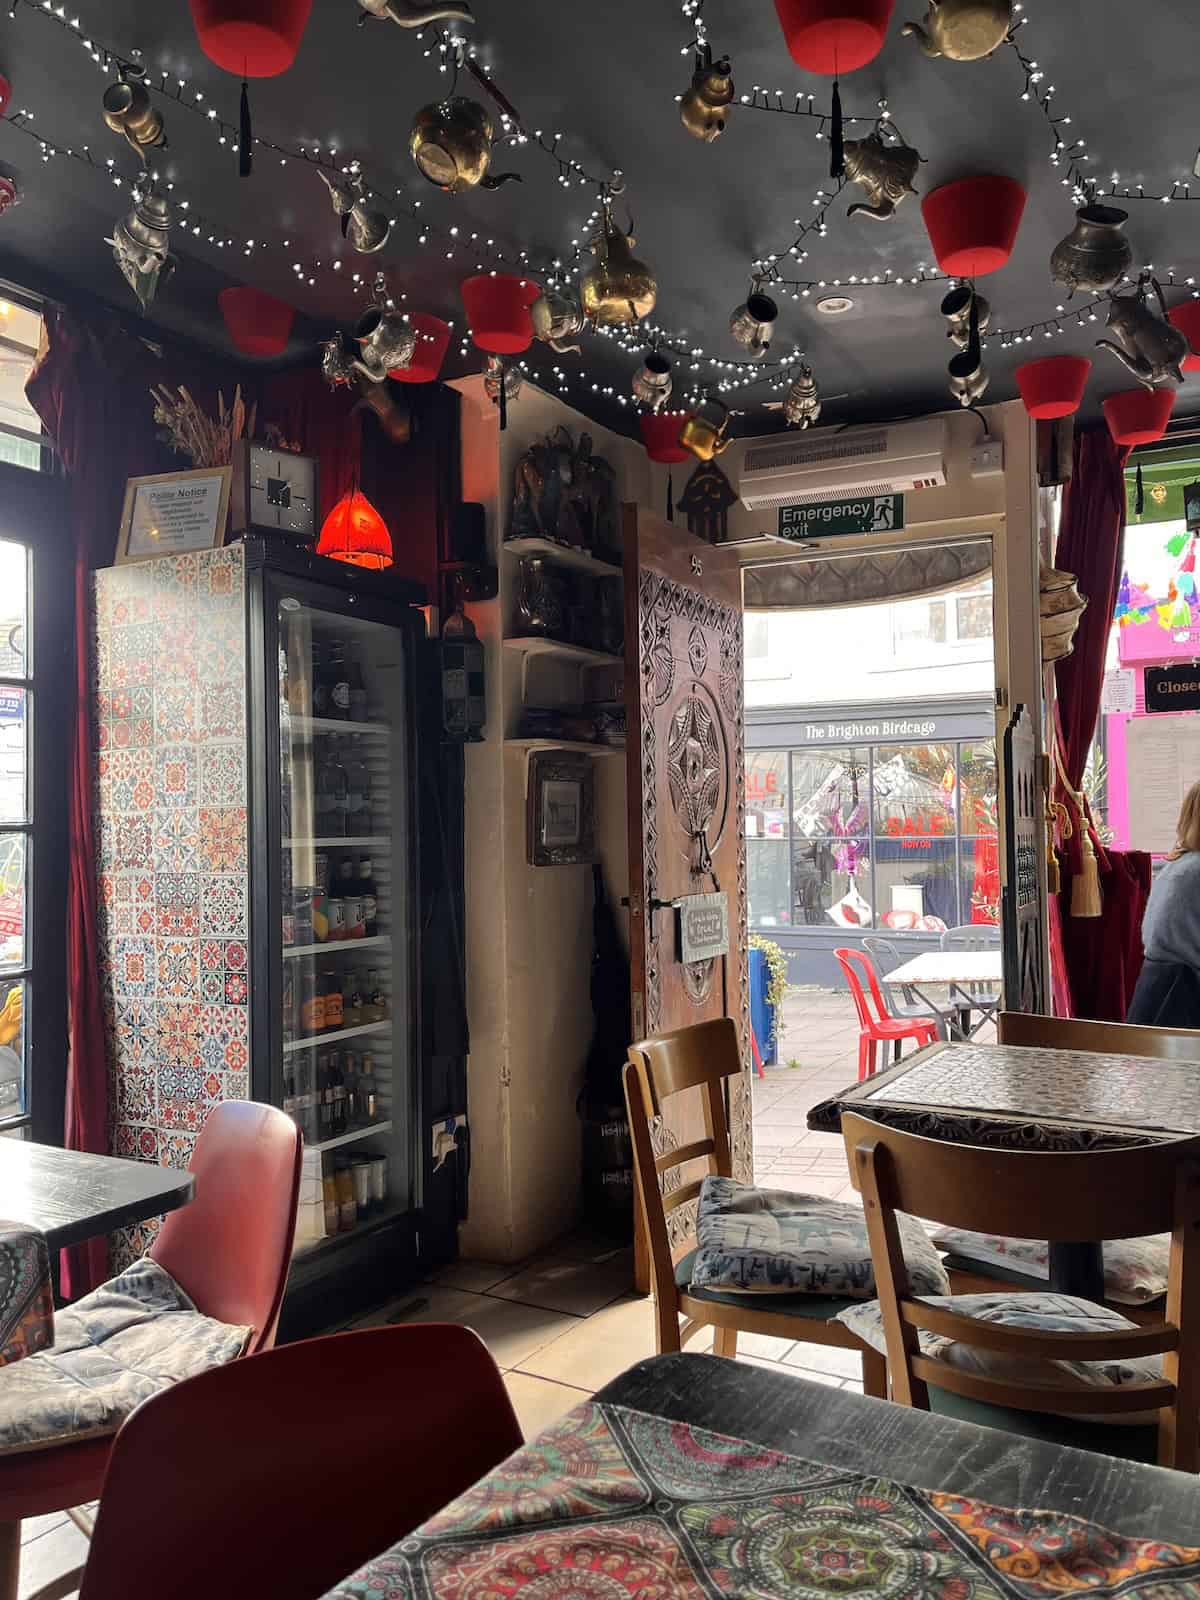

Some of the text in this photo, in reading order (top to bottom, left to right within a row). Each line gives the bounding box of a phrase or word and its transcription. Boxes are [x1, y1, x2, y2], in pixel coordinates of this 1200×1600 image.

[177, 486, 208, 497] Notice
[782, 502, 870, 523] Emergency
[782, 522, 809, 538] exit
[805, 720, 936, 740] The Brighton Birdcage
[887, 815, 945, 838] SALE
